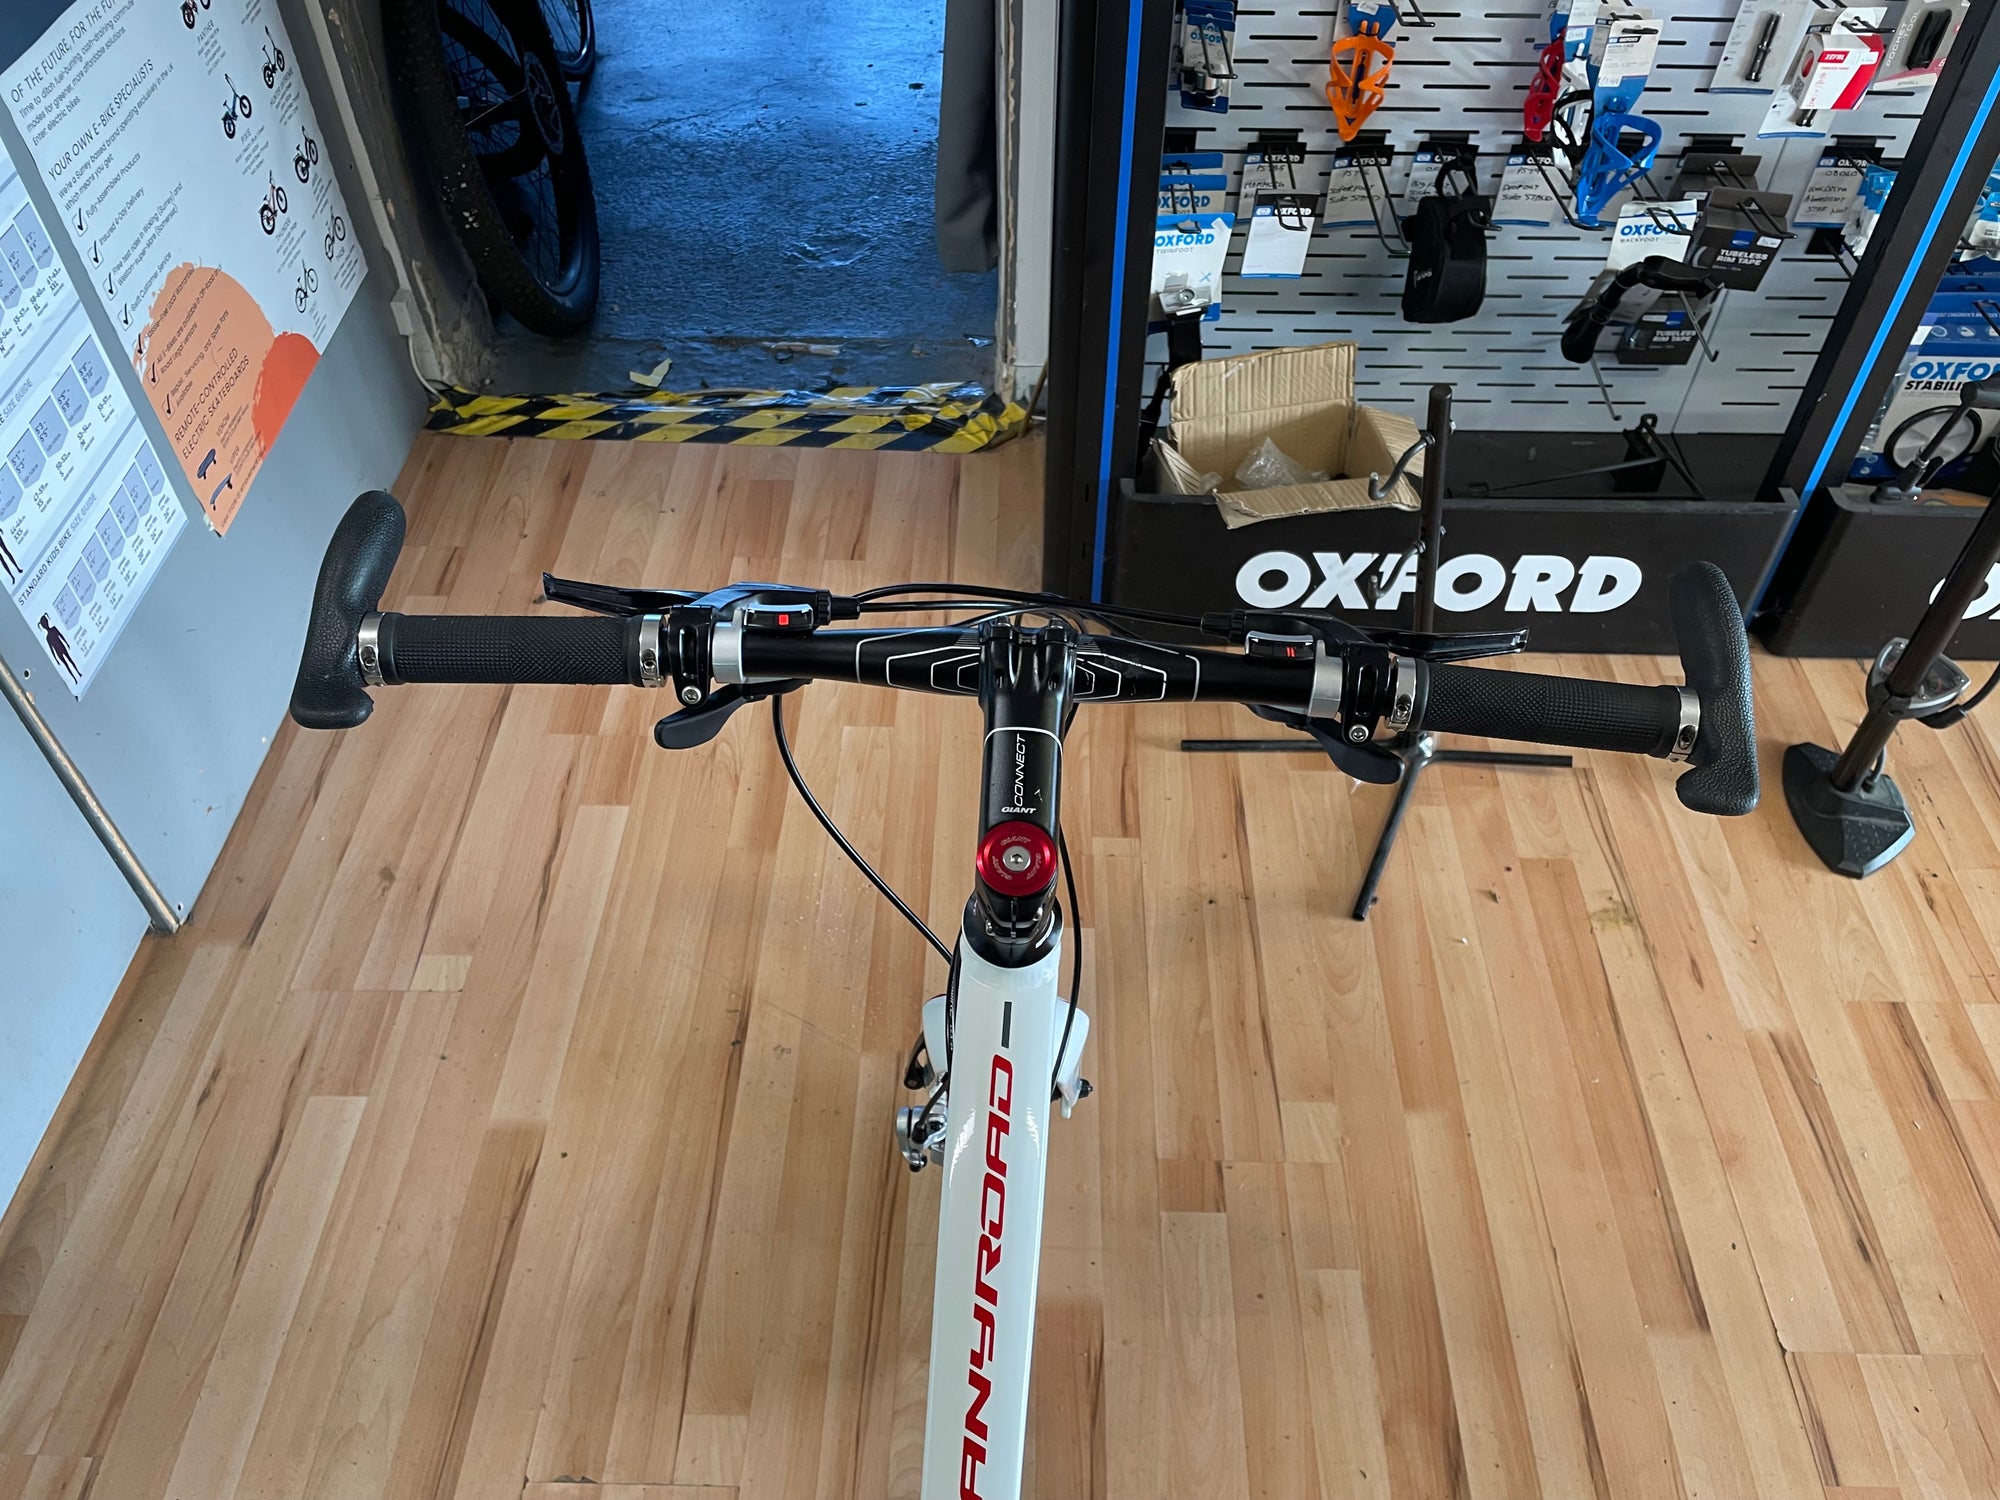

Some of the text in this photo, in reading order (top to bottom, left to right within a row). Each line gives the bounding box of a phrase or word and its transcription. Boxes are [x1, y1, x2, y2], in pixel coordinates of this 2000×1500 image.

[1903, 12, 1920, 39] TOOL
[11, 83, 25, 103] OF
[24, 67, 43, 90] THE
[41, 38, 72, 74] FUTURE,
[69, 21, 87, 43] FOR
[85, 6, 102, 27] THE
[19, 102, 34, 119] Time
[34, 96, 41, 105] to
[41, 82, 56, 99] ditch
[26, 112, 46, 133] modes
[44, 103, 54, 115] for
[71, 70, 84, 86] more
[47, 109, 67, 131] electric
[48, 59, 154, 181] YOUR OWN E-BIKE SPECIALISTS
[75, 159, 92, 179] Surrey
[90, 143, 107, 163] based
[105, 127, 121, 147] brand
[119, 106, 140, 132] operating
[137, 83, 158, 109] exclusively
[64, 191, 81, 211] Which
[79, 175, 96, 195] means
[94, 165, 105, 178] you
[99, 222, 116, 246] Insured
[1155, 233, 1215, 247] OXFORD
[1720, 249, 1769, 261] TUBELESS
[140, 270, 159, 298] Customer
[157, 252, 172, 273] Service
[1716, 255, 1736, 263] RIM
[160, 358, 173, 374] Road
[1904, 381, 1964, 391] STABILI
[3, 378, 33, 418] SIZE GUIDE
[174, 347, 239, 444] REMOTE-CONTROLLED
[181, 414, 210, 460] ELECTRIC
[207, 354, 250, 418] SKATEBOARDS
[18, 491, 97, 606] STANDARD KIDS BIKE SIZE GUIDE
[1235, 550, 1643, 613] OXFORD
[1014, 732, 1027, 807] CONNECT
[1001, 806, 1037, 814] GIANT
[1000, 835, 1032, 846] GIANT
[959, 1053, 1015, 1500] ANYROAD
